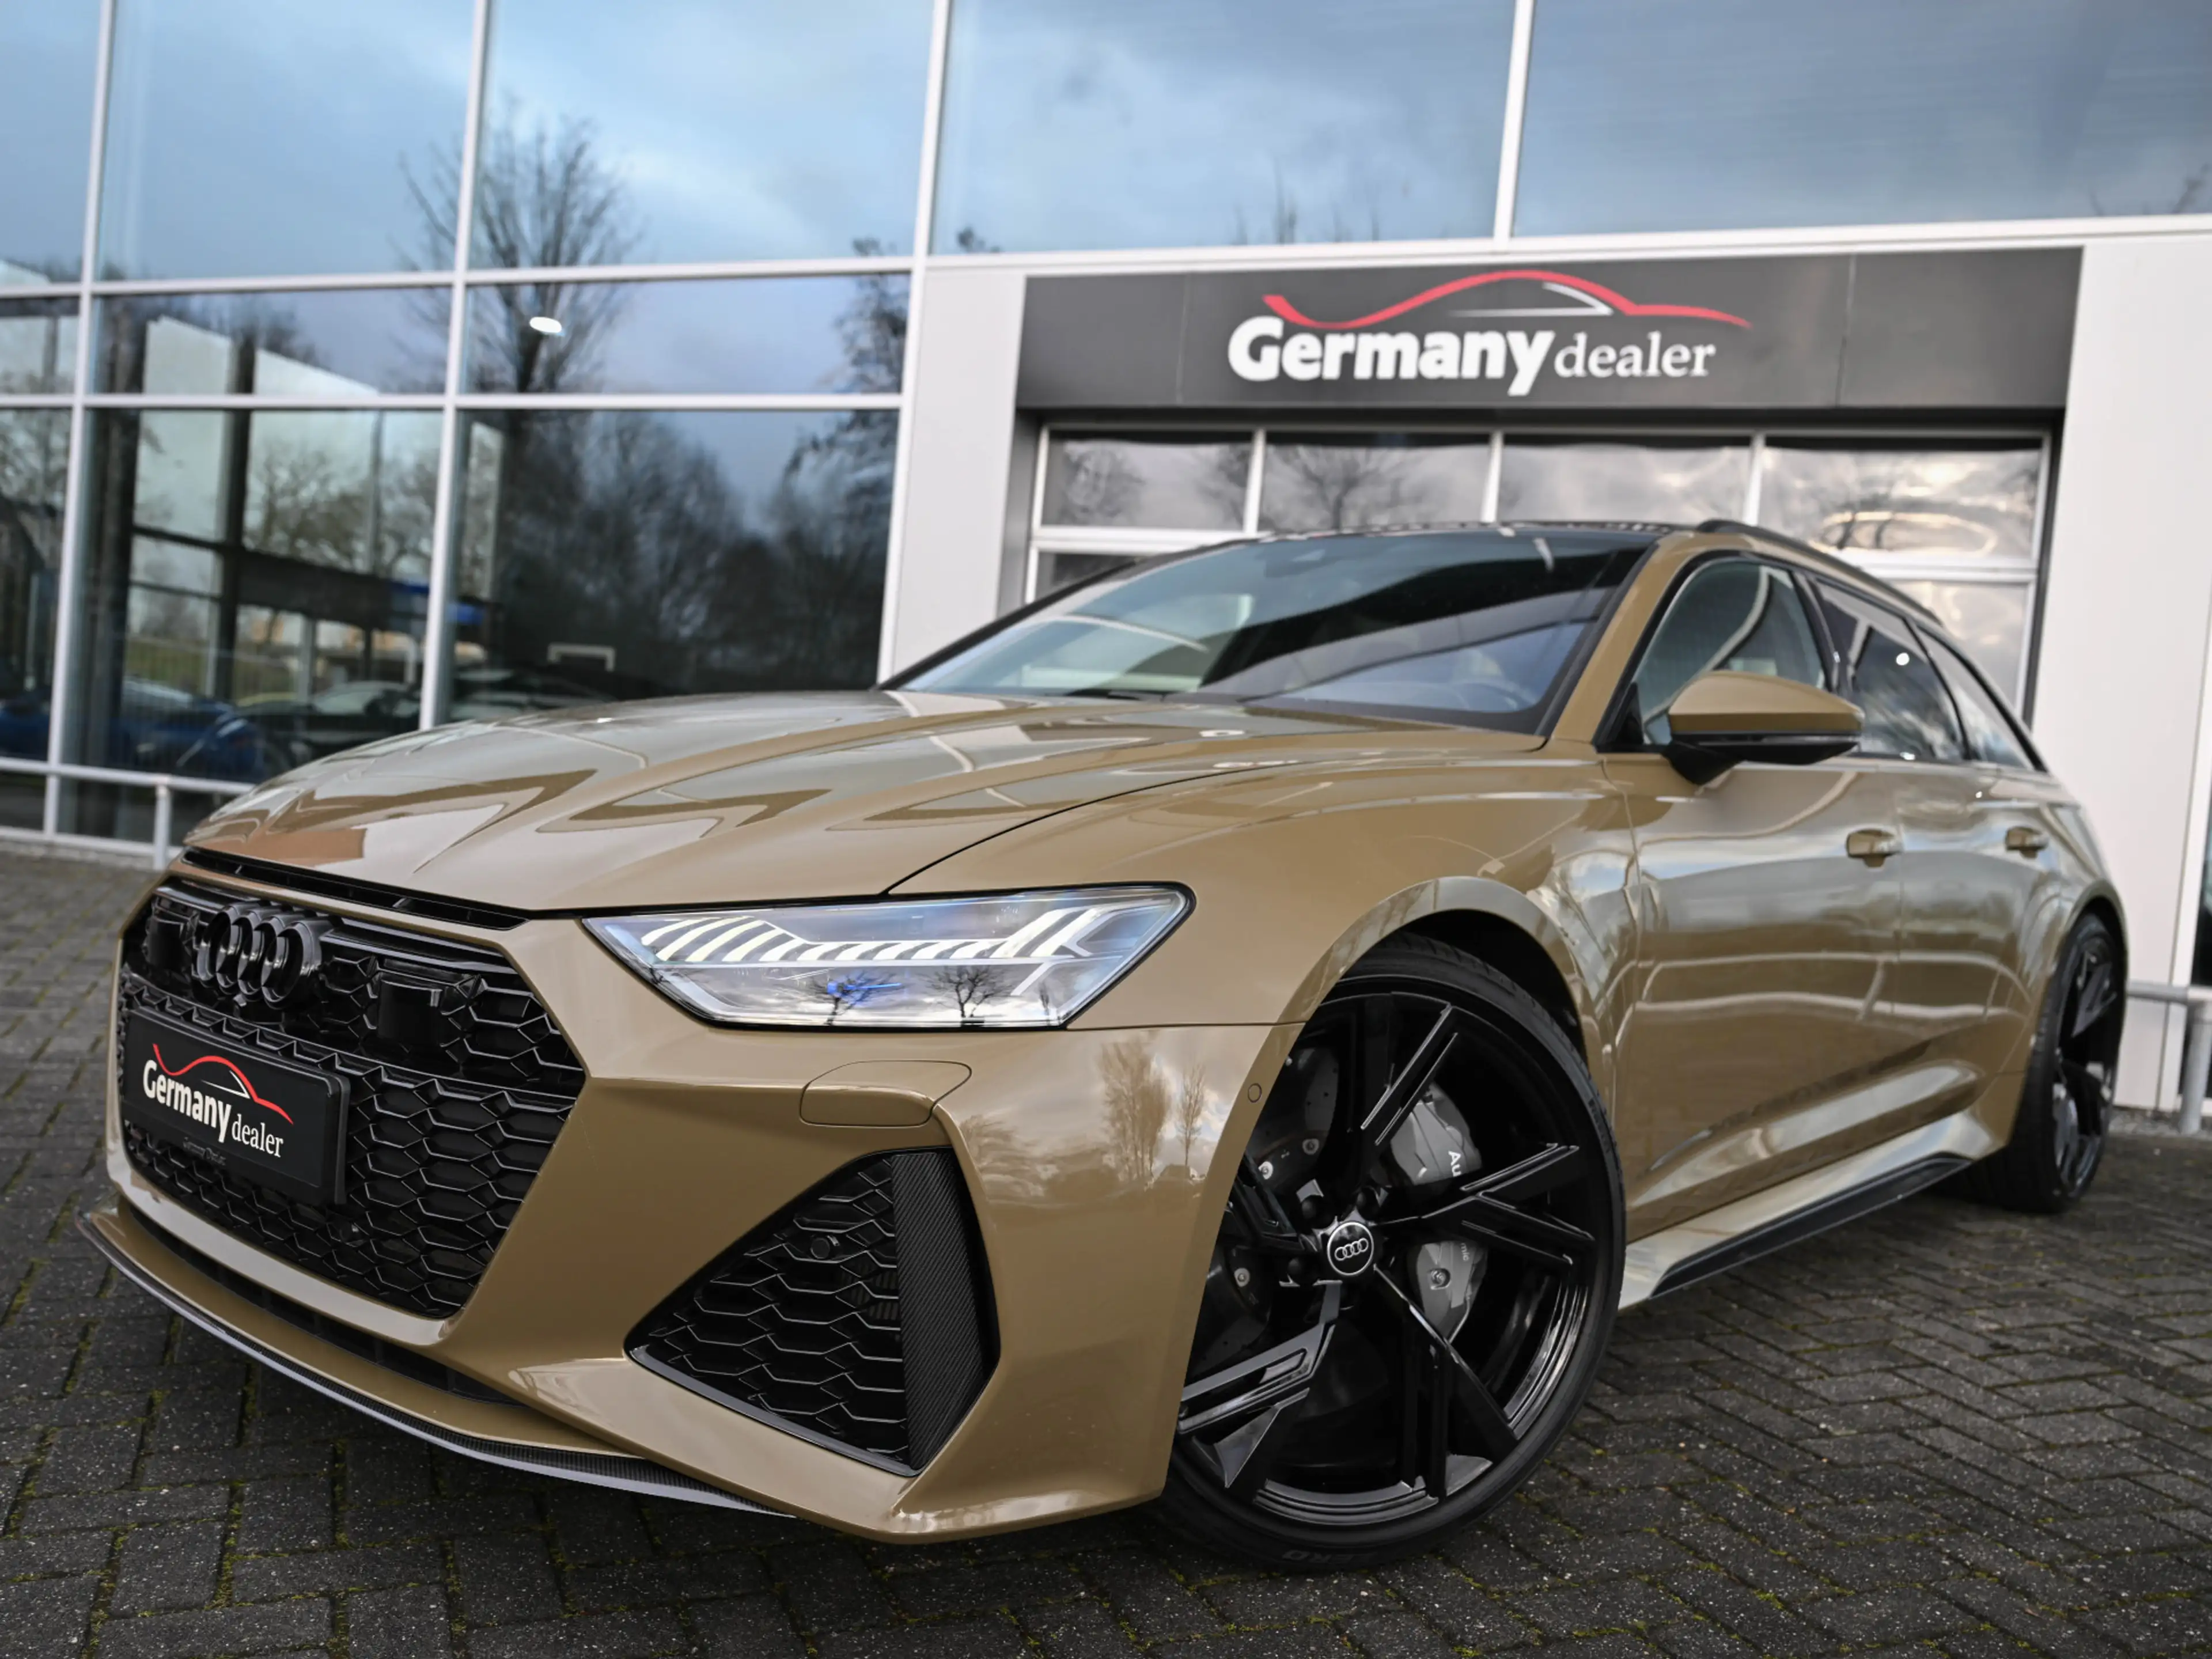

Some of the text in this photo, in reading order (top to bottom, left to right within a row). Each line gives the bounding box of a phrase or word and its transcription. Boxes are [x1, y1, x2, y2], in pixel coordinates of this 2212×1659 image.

[1228, 316, 1717, 397] Germany dealer
[143, 1059, 232, 1143] Germany
[231, 1113, 284, 1158] dealer
